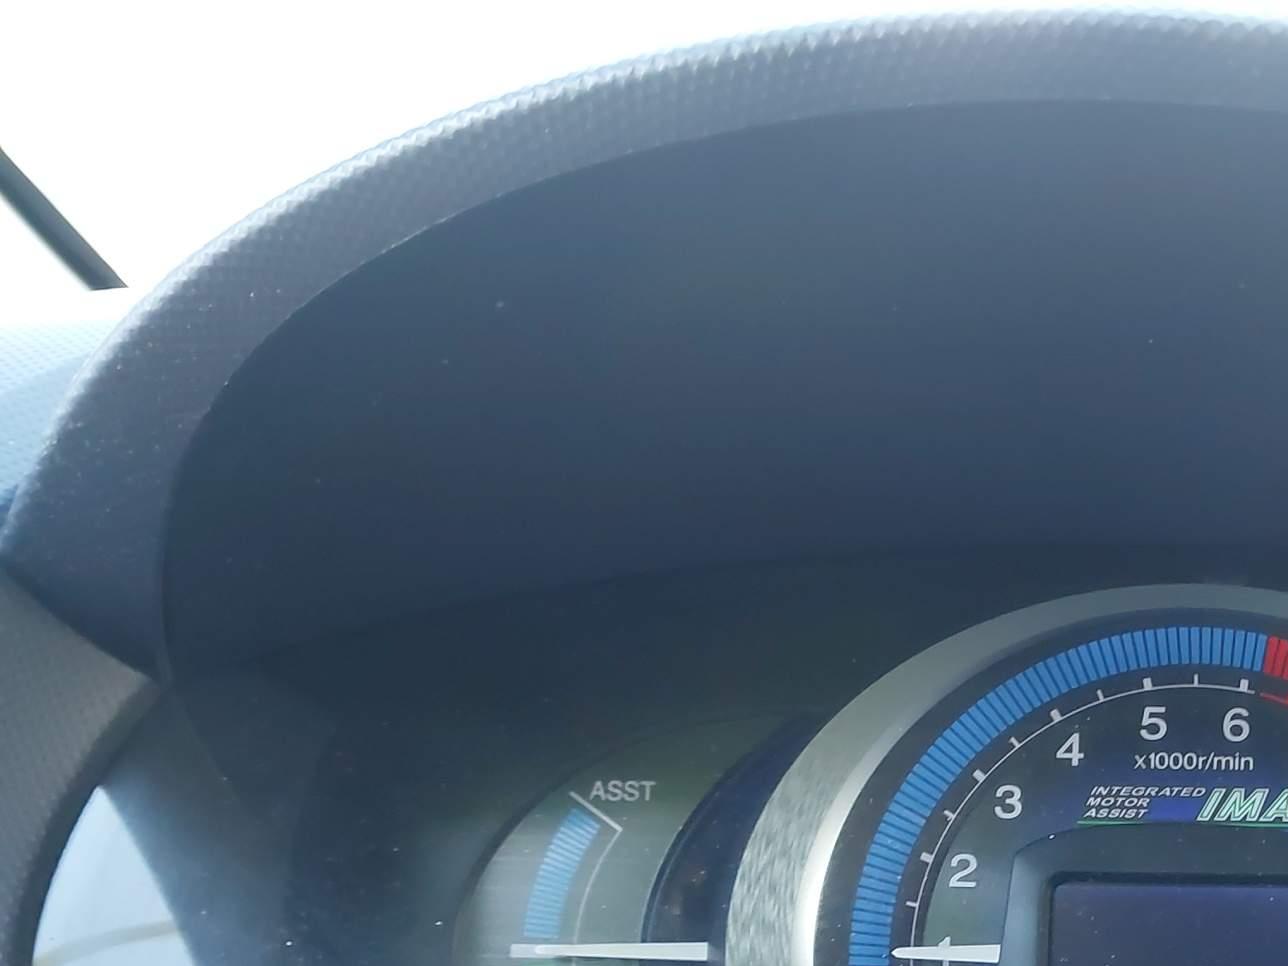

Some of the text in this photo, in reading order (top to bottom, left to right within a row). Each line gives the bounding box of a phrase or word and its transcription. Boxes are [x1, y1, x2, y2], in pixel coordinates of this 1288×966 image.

[1140, 706, 1167, 740] 5
[1222, 708, 1250, 742] 6
[1056, 734, 1085, 767] 4
[1134, 751, 1254, 772] x1000r/min
[589, 780, 655, 801] ASST
[994, 785, 1022, 819] 3
[1086, 797, 1150, 808] MOTOR
[1091, 786, 1206, 798] INTEGRATED
[1084, 808, 1149, 819] ASSIST
[949, 854, 977, 888] 2
